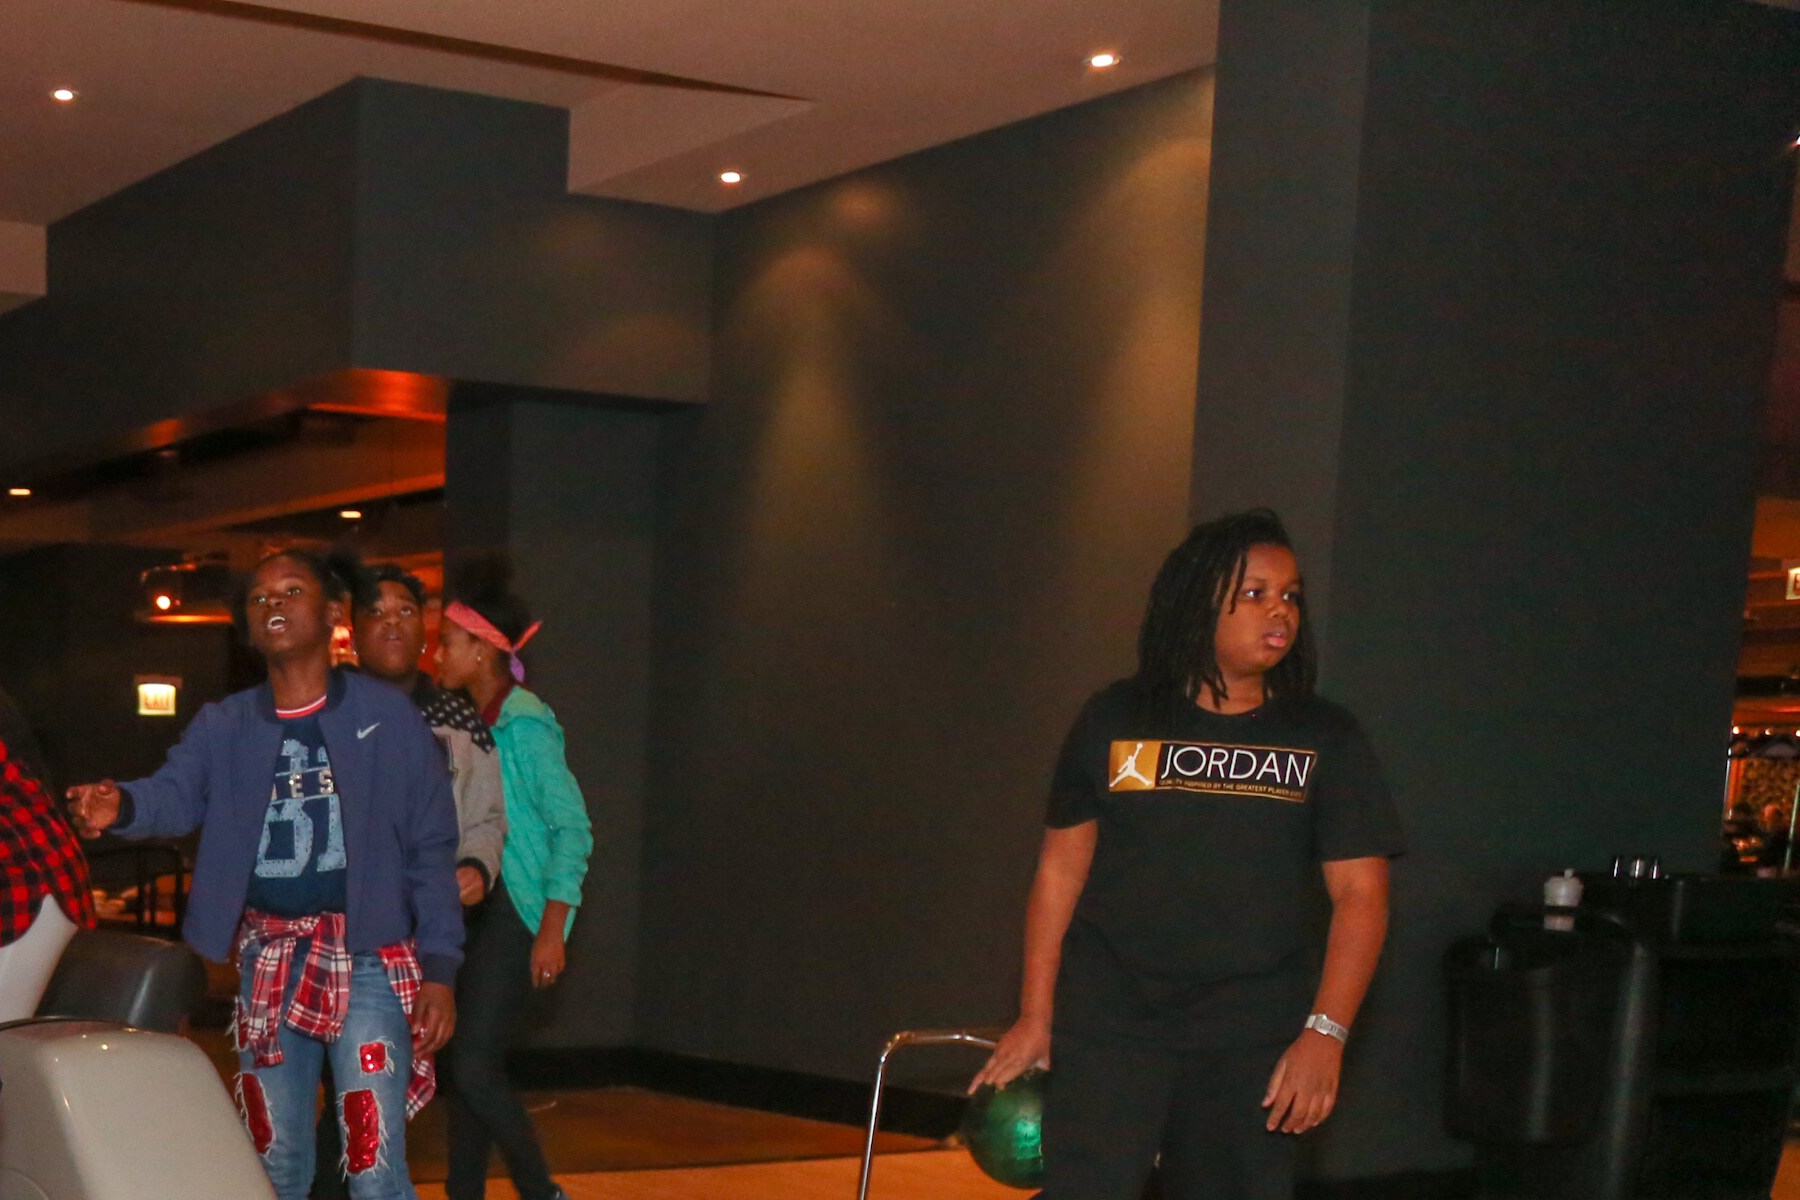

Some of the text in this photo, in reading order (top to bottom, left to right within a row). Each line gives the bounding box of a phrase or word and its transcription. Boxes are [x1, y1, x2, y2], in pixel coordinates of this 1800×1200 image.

[1160, 745, 1310, 788] JORDAN
[1223, 783, 1234, 791] THE
[1235, 783, 1267, 793] GREATEST
